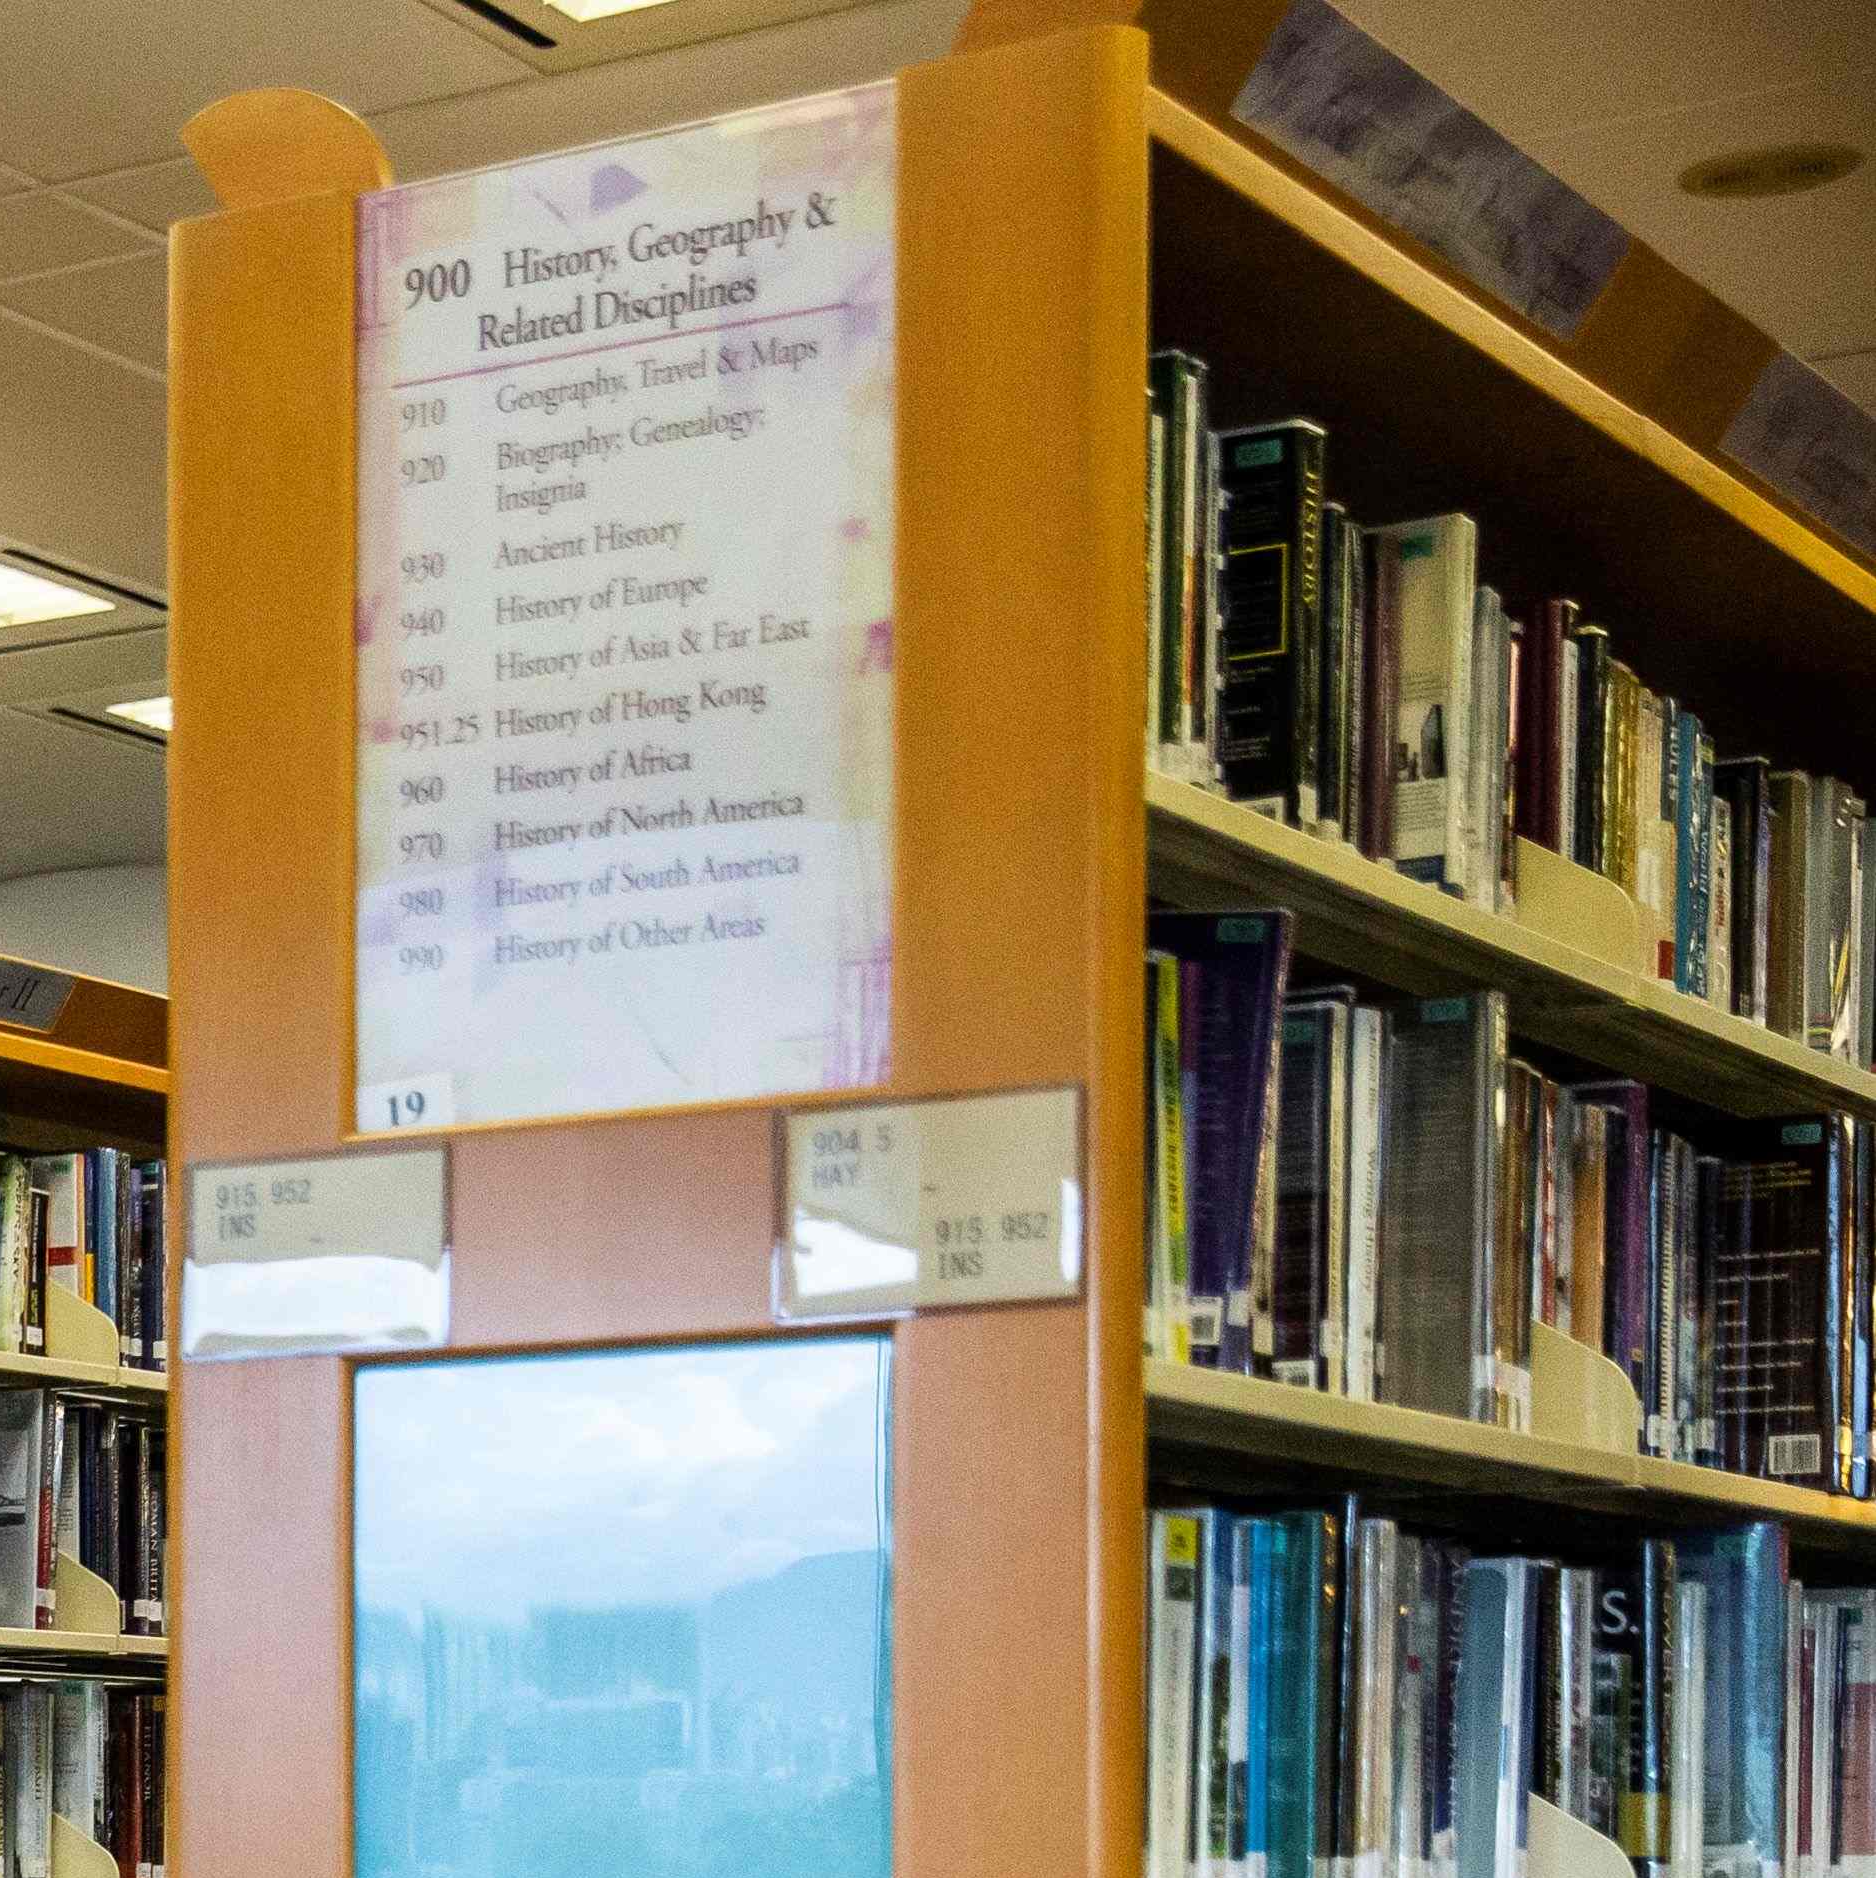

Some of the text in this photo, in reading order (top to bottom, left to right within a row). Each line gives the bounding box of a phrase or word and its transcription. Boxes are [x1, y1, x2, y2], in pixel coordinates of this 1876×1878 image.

[405, 190, 836, 310] 900 History, Geography &
[478, 271, 757, 352] Related Disciplines
[401, 398, 445, 432] 910
[635, 348, 708, 388] Travel
[716, 346, 742, 375] &
[750, 336, 818, 374] Maps
[401, 454, 445, 488] 920
[496, 476, 586, 517] Insignia
[400, 517, 686, 584] 930 Ancient History
[400, 573, 709, 640] 940 History of Europe
[400, 614, 810, 693] 950 History of Asia & Far East
[399, 676, 768, 751] 951.25 History of Hong Kong
[399, 744, 694, 804] 960 History of Africa
[399, 792, 805, 863] 970 History of North America
[399, 849, 800, 917] 980 History of South America
[398, 911, 767, 972] 990 History of Other Areas
[14, 978, 42, 1013] II
[386, 1090, 427, 1129] 19
